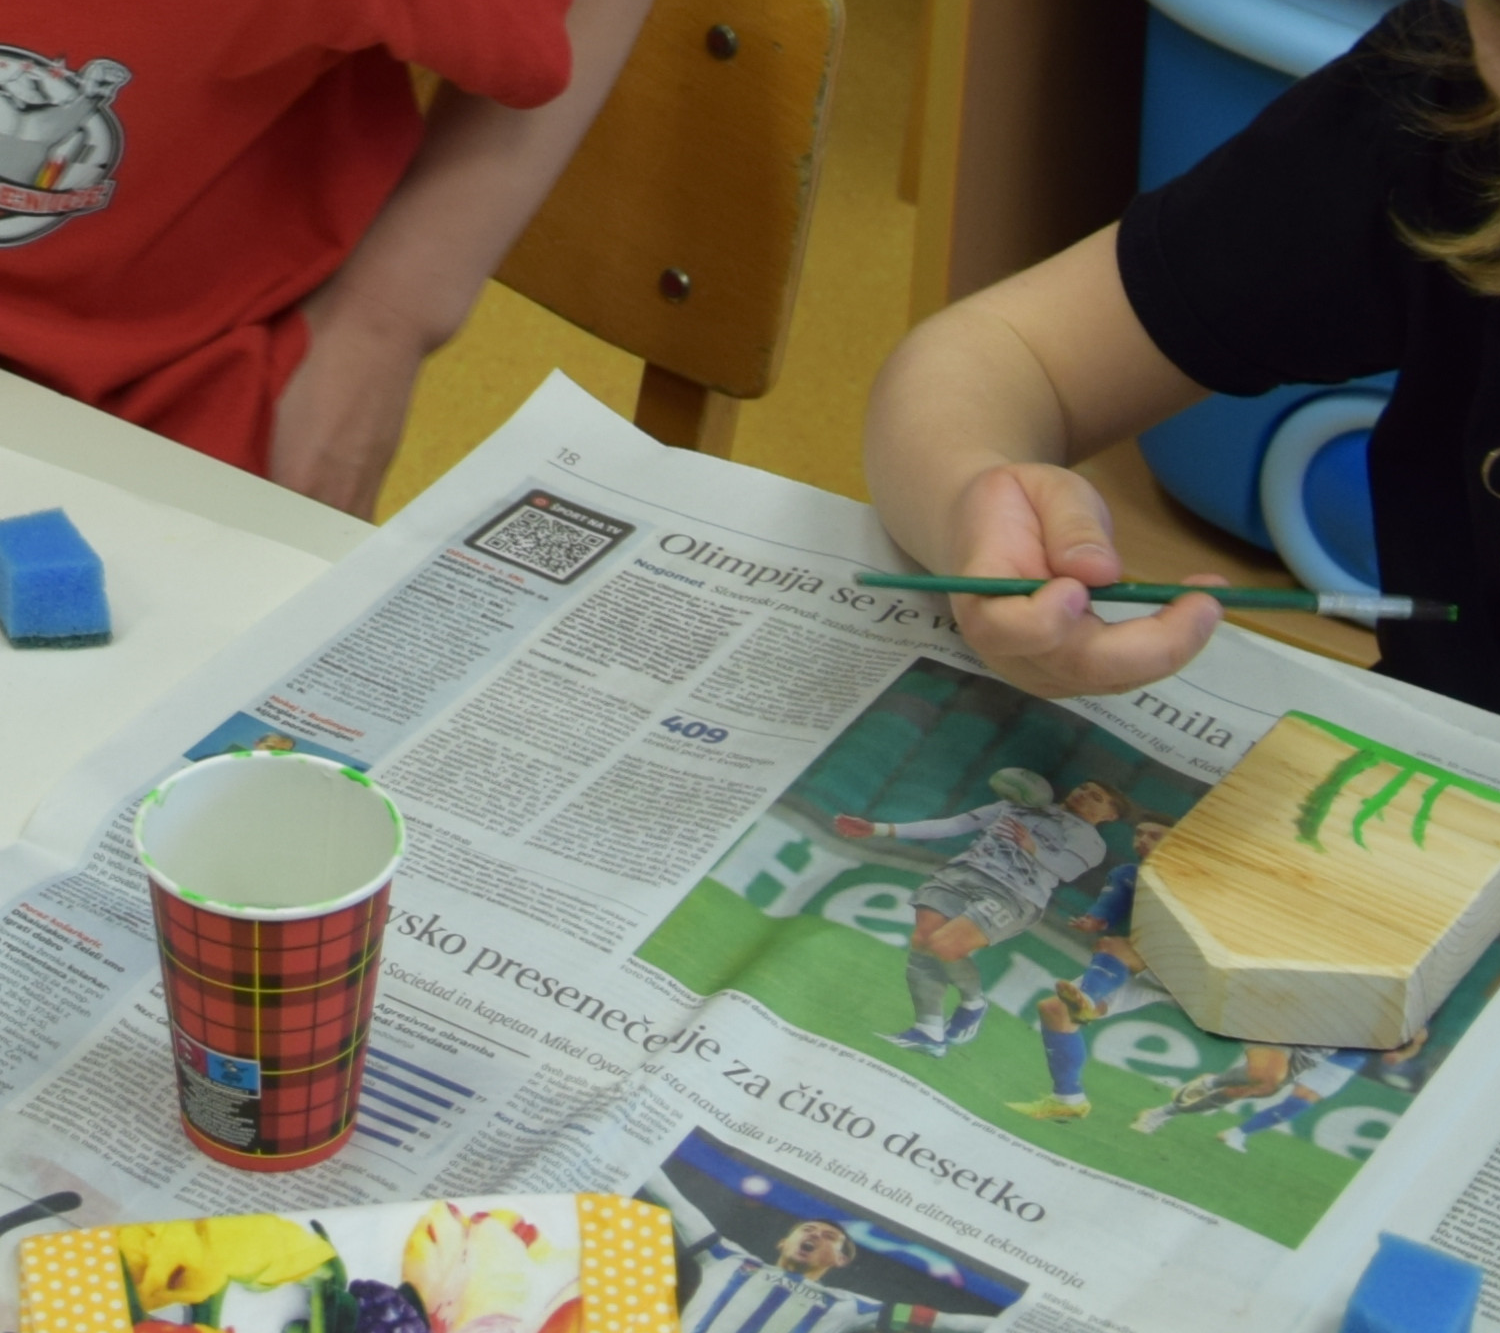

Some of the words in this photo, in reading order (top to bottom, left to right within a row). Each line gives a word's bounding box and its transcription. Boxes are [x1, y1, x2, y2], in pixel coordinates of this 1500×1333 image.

[555, 446, 581, 467] 18
[632, 557, 707, 590] Nogomet
[710, 583, 777, 609] Slovenski
[1072, 695, 1148, 740] onferenčni
[1148, 735, 1176, 755] ligi
[657, 531, 826, 596] Olimpija
[829, 584, 875, 614] se
[873, 590, 922, 627] je
[1130, 690, 1235, 750] rnila
[659, 714, 730, 745] 409
[2, 915, 34, 935] igrati
[31, 931, 63, 952] dobro
[102, 958, 126, 974] smo
[374, 1002, 436, 1034] Agresivna
[438, 1029, 496, 1060] obramba
[392, 1021, 459, 1056] Sociedada
[385, 903, 469, 957] vsko
[721, 1056, 773, 1101] za
[777, 1080, 878, 1141] čisto
[881, 1129, 1047, 1225] desetko
[383, 959, 458, 1002] Sociedad
[456, 990, 474, 1009] in
[473, 998, 540, 1041] kapetan
[538, 1031, 589, 1061] Mikel
[660, 1067, 688, 1094] sta
[687, 1088, 765, 1145] navdušila
[765, 1133, 780, 1147] v
[775, 1137, 824, 1170] prvih
[823, 1156, 871, 1192] štirih
[868, 1176, 916, 1210] kolih
[913, 1197, 983, 1241] elitnega
[982, 1231, 1086, 1292] tekmovanja
